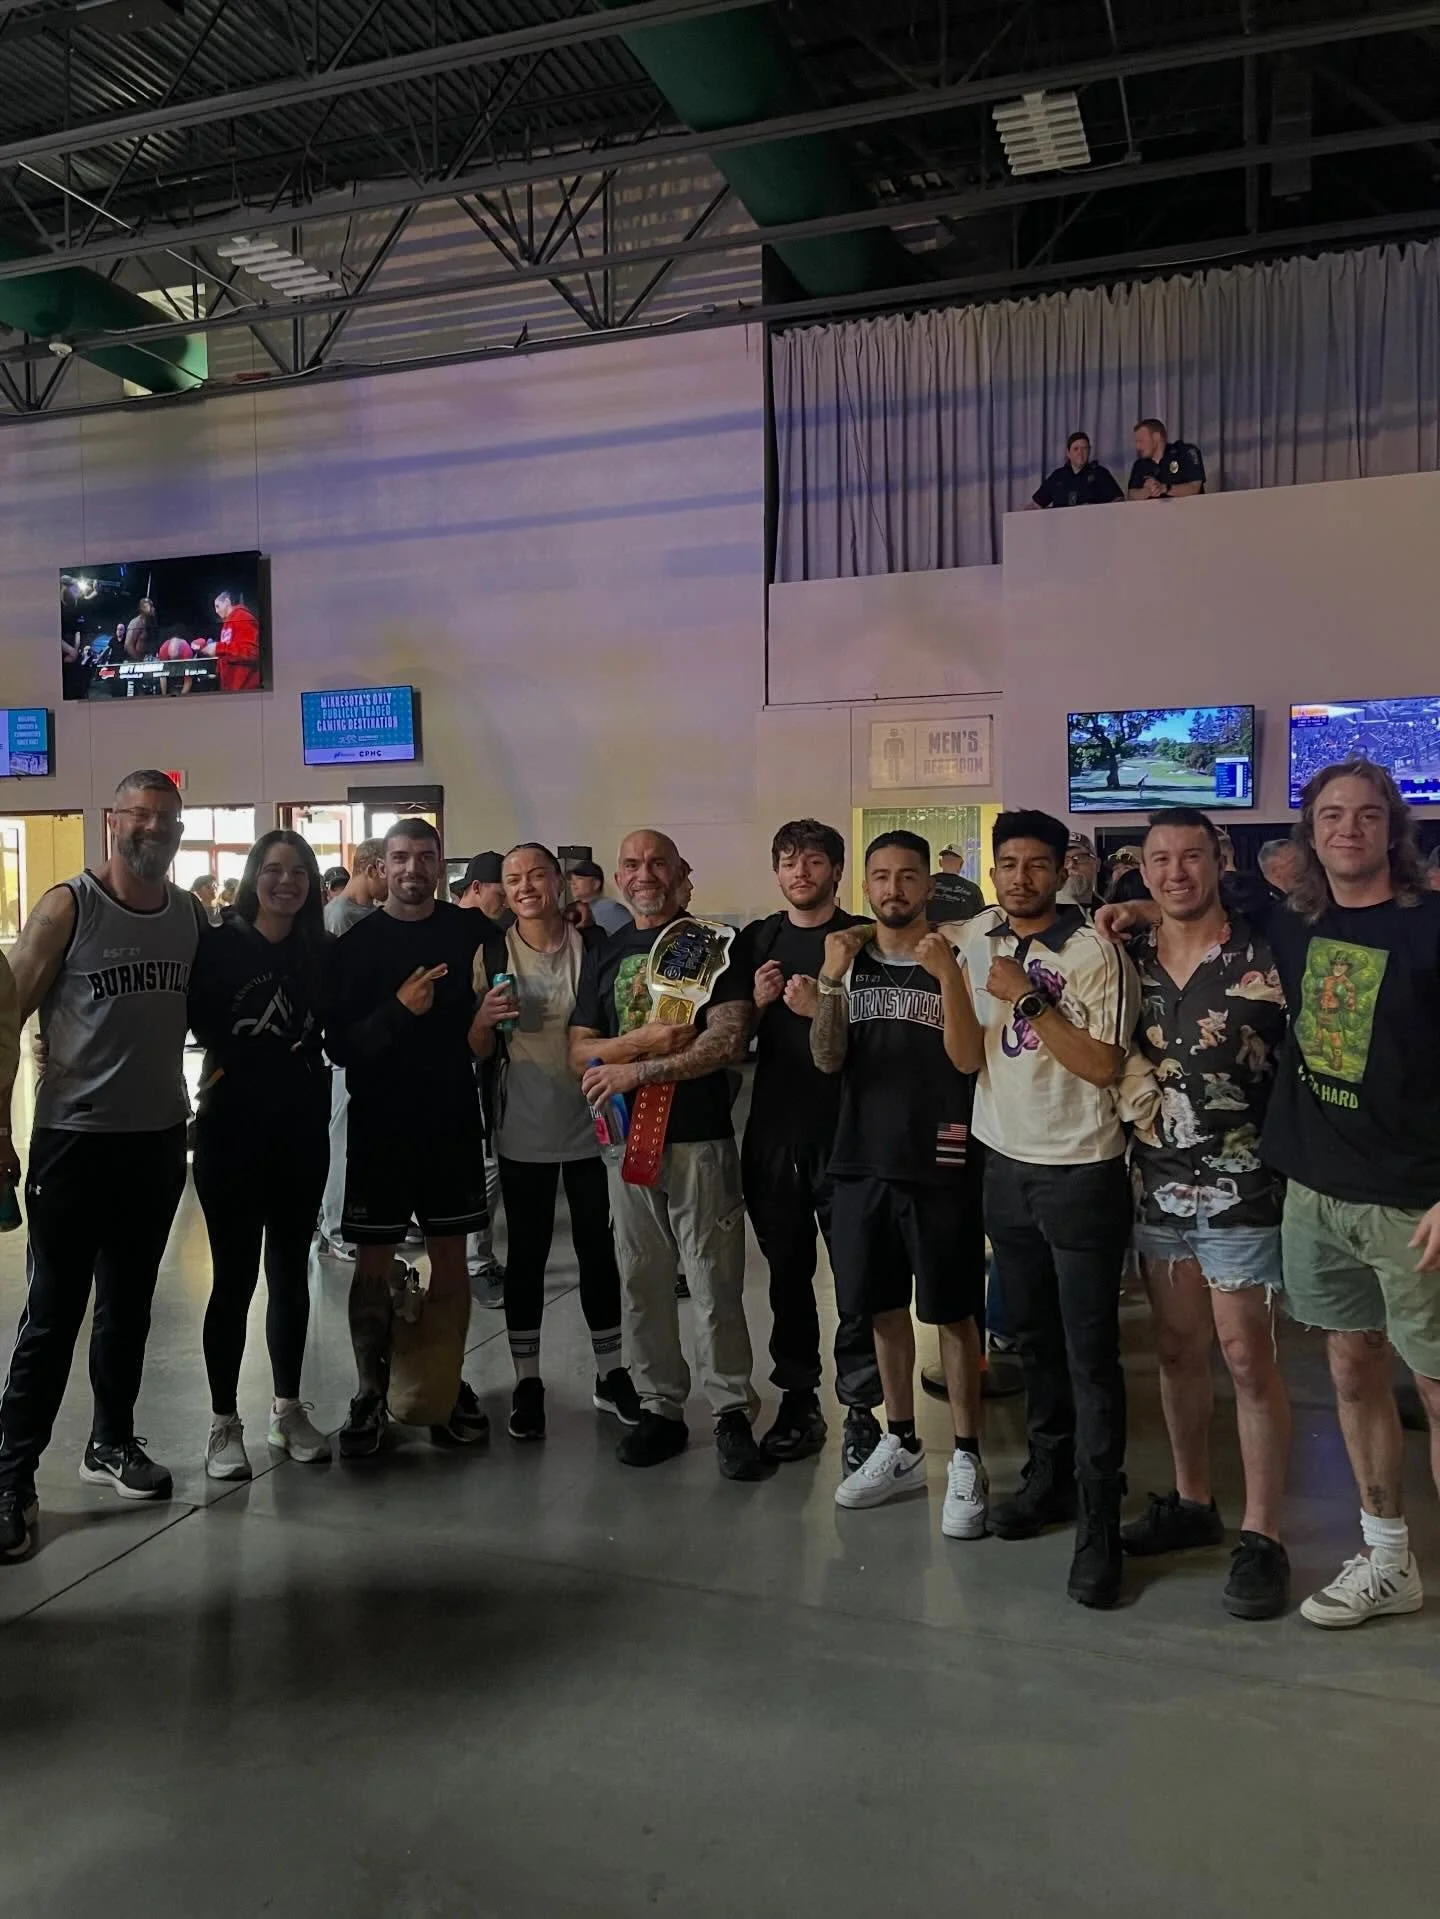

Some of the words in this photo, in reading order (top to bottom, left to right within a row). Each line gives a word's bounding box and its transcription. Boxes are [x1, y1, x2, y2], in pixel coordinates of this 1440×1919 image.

[320, 694, 371, 708] MINNESOTA'S
[372, 692, 392, 705] ONLY
[322, 706, 360, 720] PUBLICLY
[361, 705, 391, 718] TRADED
[317, 719, 347, 731] GAMING
[348, 715, 398, 730] DESTINATION
[929, 731, 978, 753] MEN'S
[924, 758, 983, 774] REOOM
[86, 960, 191, 1001] BURNSVILL
[856, 974, 870, 982] EST
[849, 987, 944, 1030] URNSVILL
[1321, 1085, 1358, 1108] HARD
